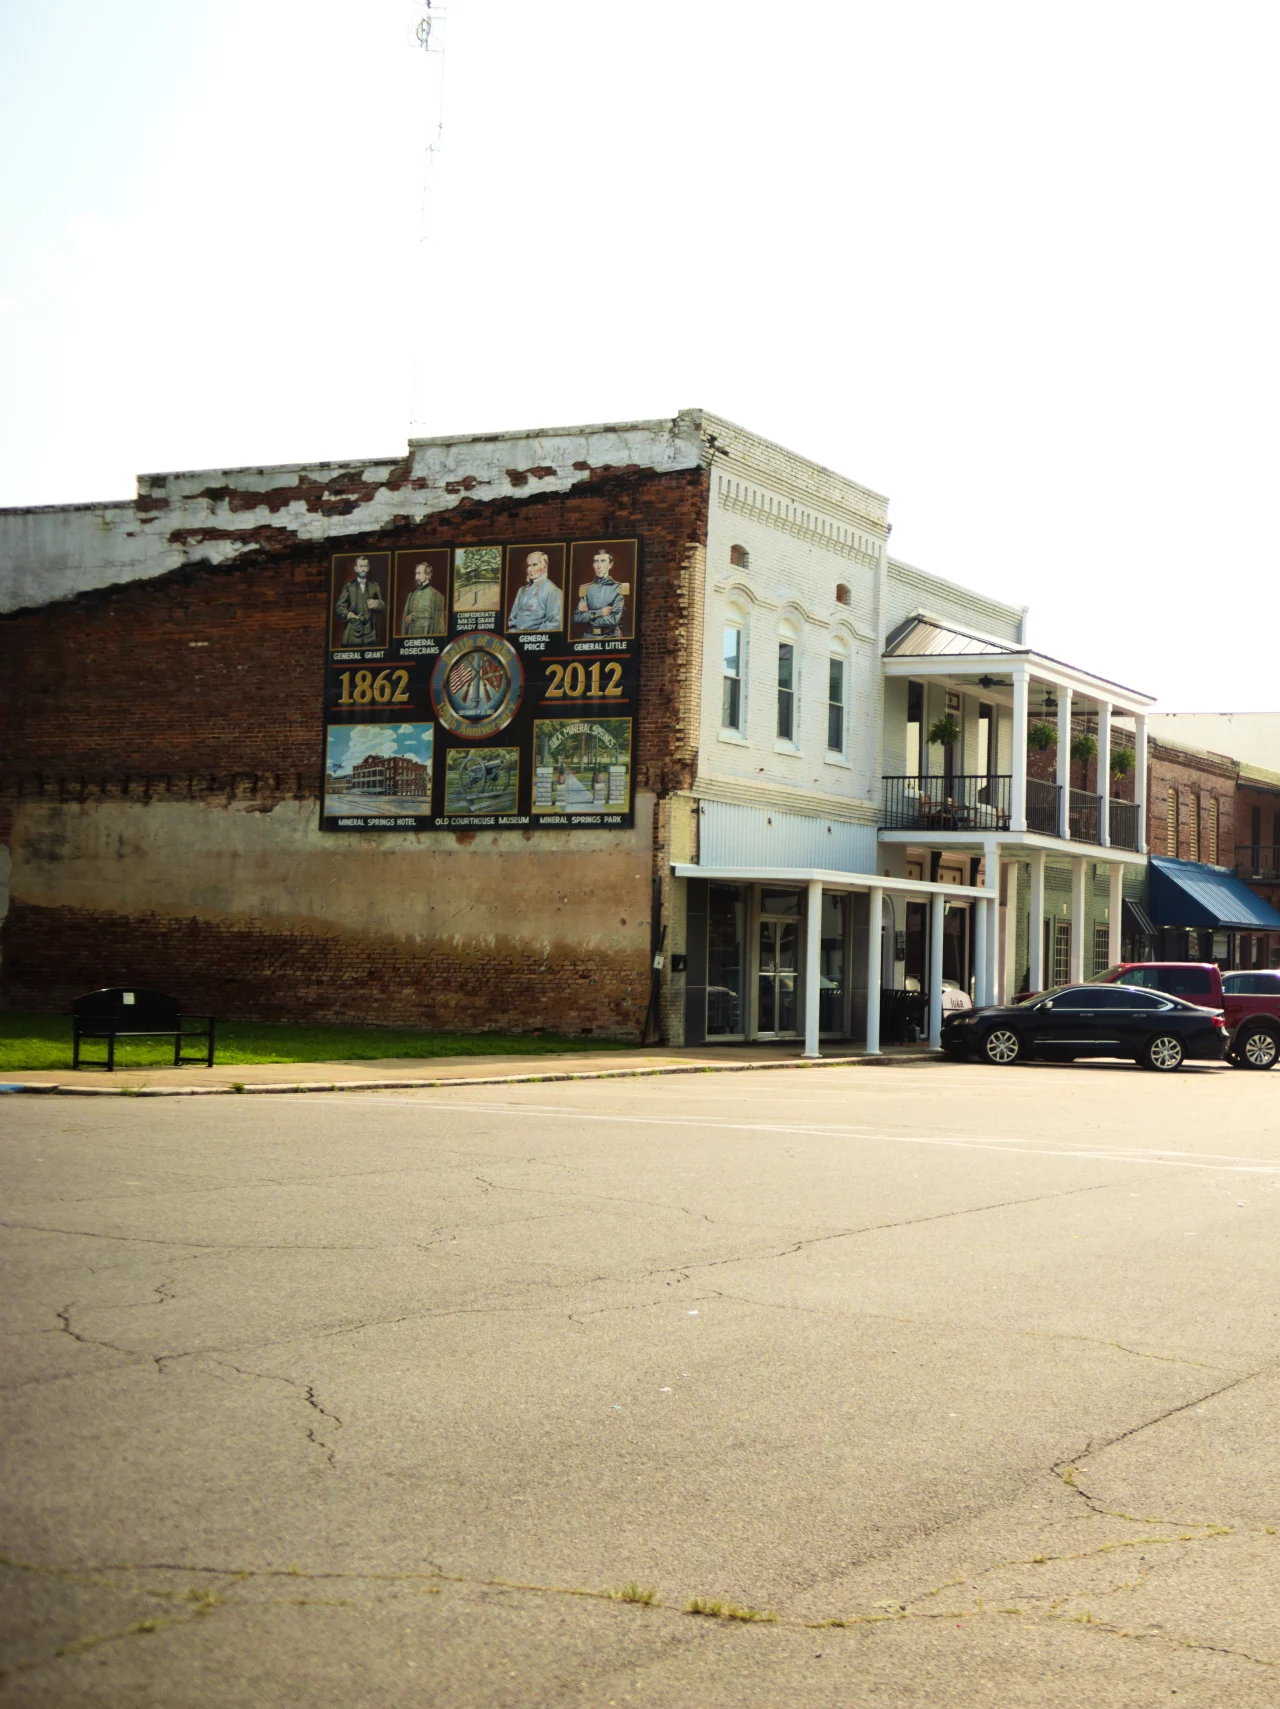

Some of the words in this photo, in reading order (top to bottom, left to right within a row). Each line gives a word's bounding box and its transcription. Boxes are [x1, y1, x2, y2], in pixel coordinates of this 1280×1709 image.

[457, 611, 496, 619] CONFEDERATE
[456, 623, 476, 631] SHADY
[518, 634, 550, 642] GENERAL
[404, 639, 435, 647] GENERAL
[524, 642, 546, 651] PRICE
[573, 642, 603, 651] GENERAL
[605, 641, 627, 650] LITTLE
[399, 646, 440, 655] ROSECRANS
[443, 637, 473, 663] Battle
[477, 635, 490, 647] of
[333, 652, 362, 660] GENERAL
[364, 650, 385, 659] GRANT
[545, 661, 623, 697] 2012
[338, 669, 410, 704] 1862
[459, 701, 516, 737] Anniversary
[562, 723, 591, 737] MINERAL
[591, 723, 615, 749] SPRINGS
[338, 818, 365, 826] MINERAL
[367, 818, 395, 826] SPRINGS
[396, 818, 417, 826] HOTEL
[435, 817, 449, 826] OLD
[451, 816, 496, 825] COURTHOUSE
[498, 816, 530, 825] MUSEUM
[539, 816, 569, 824] MINERAL
[571, 815, 601, 824] SPRINGS
[603, 815, 622, 824] PARK
